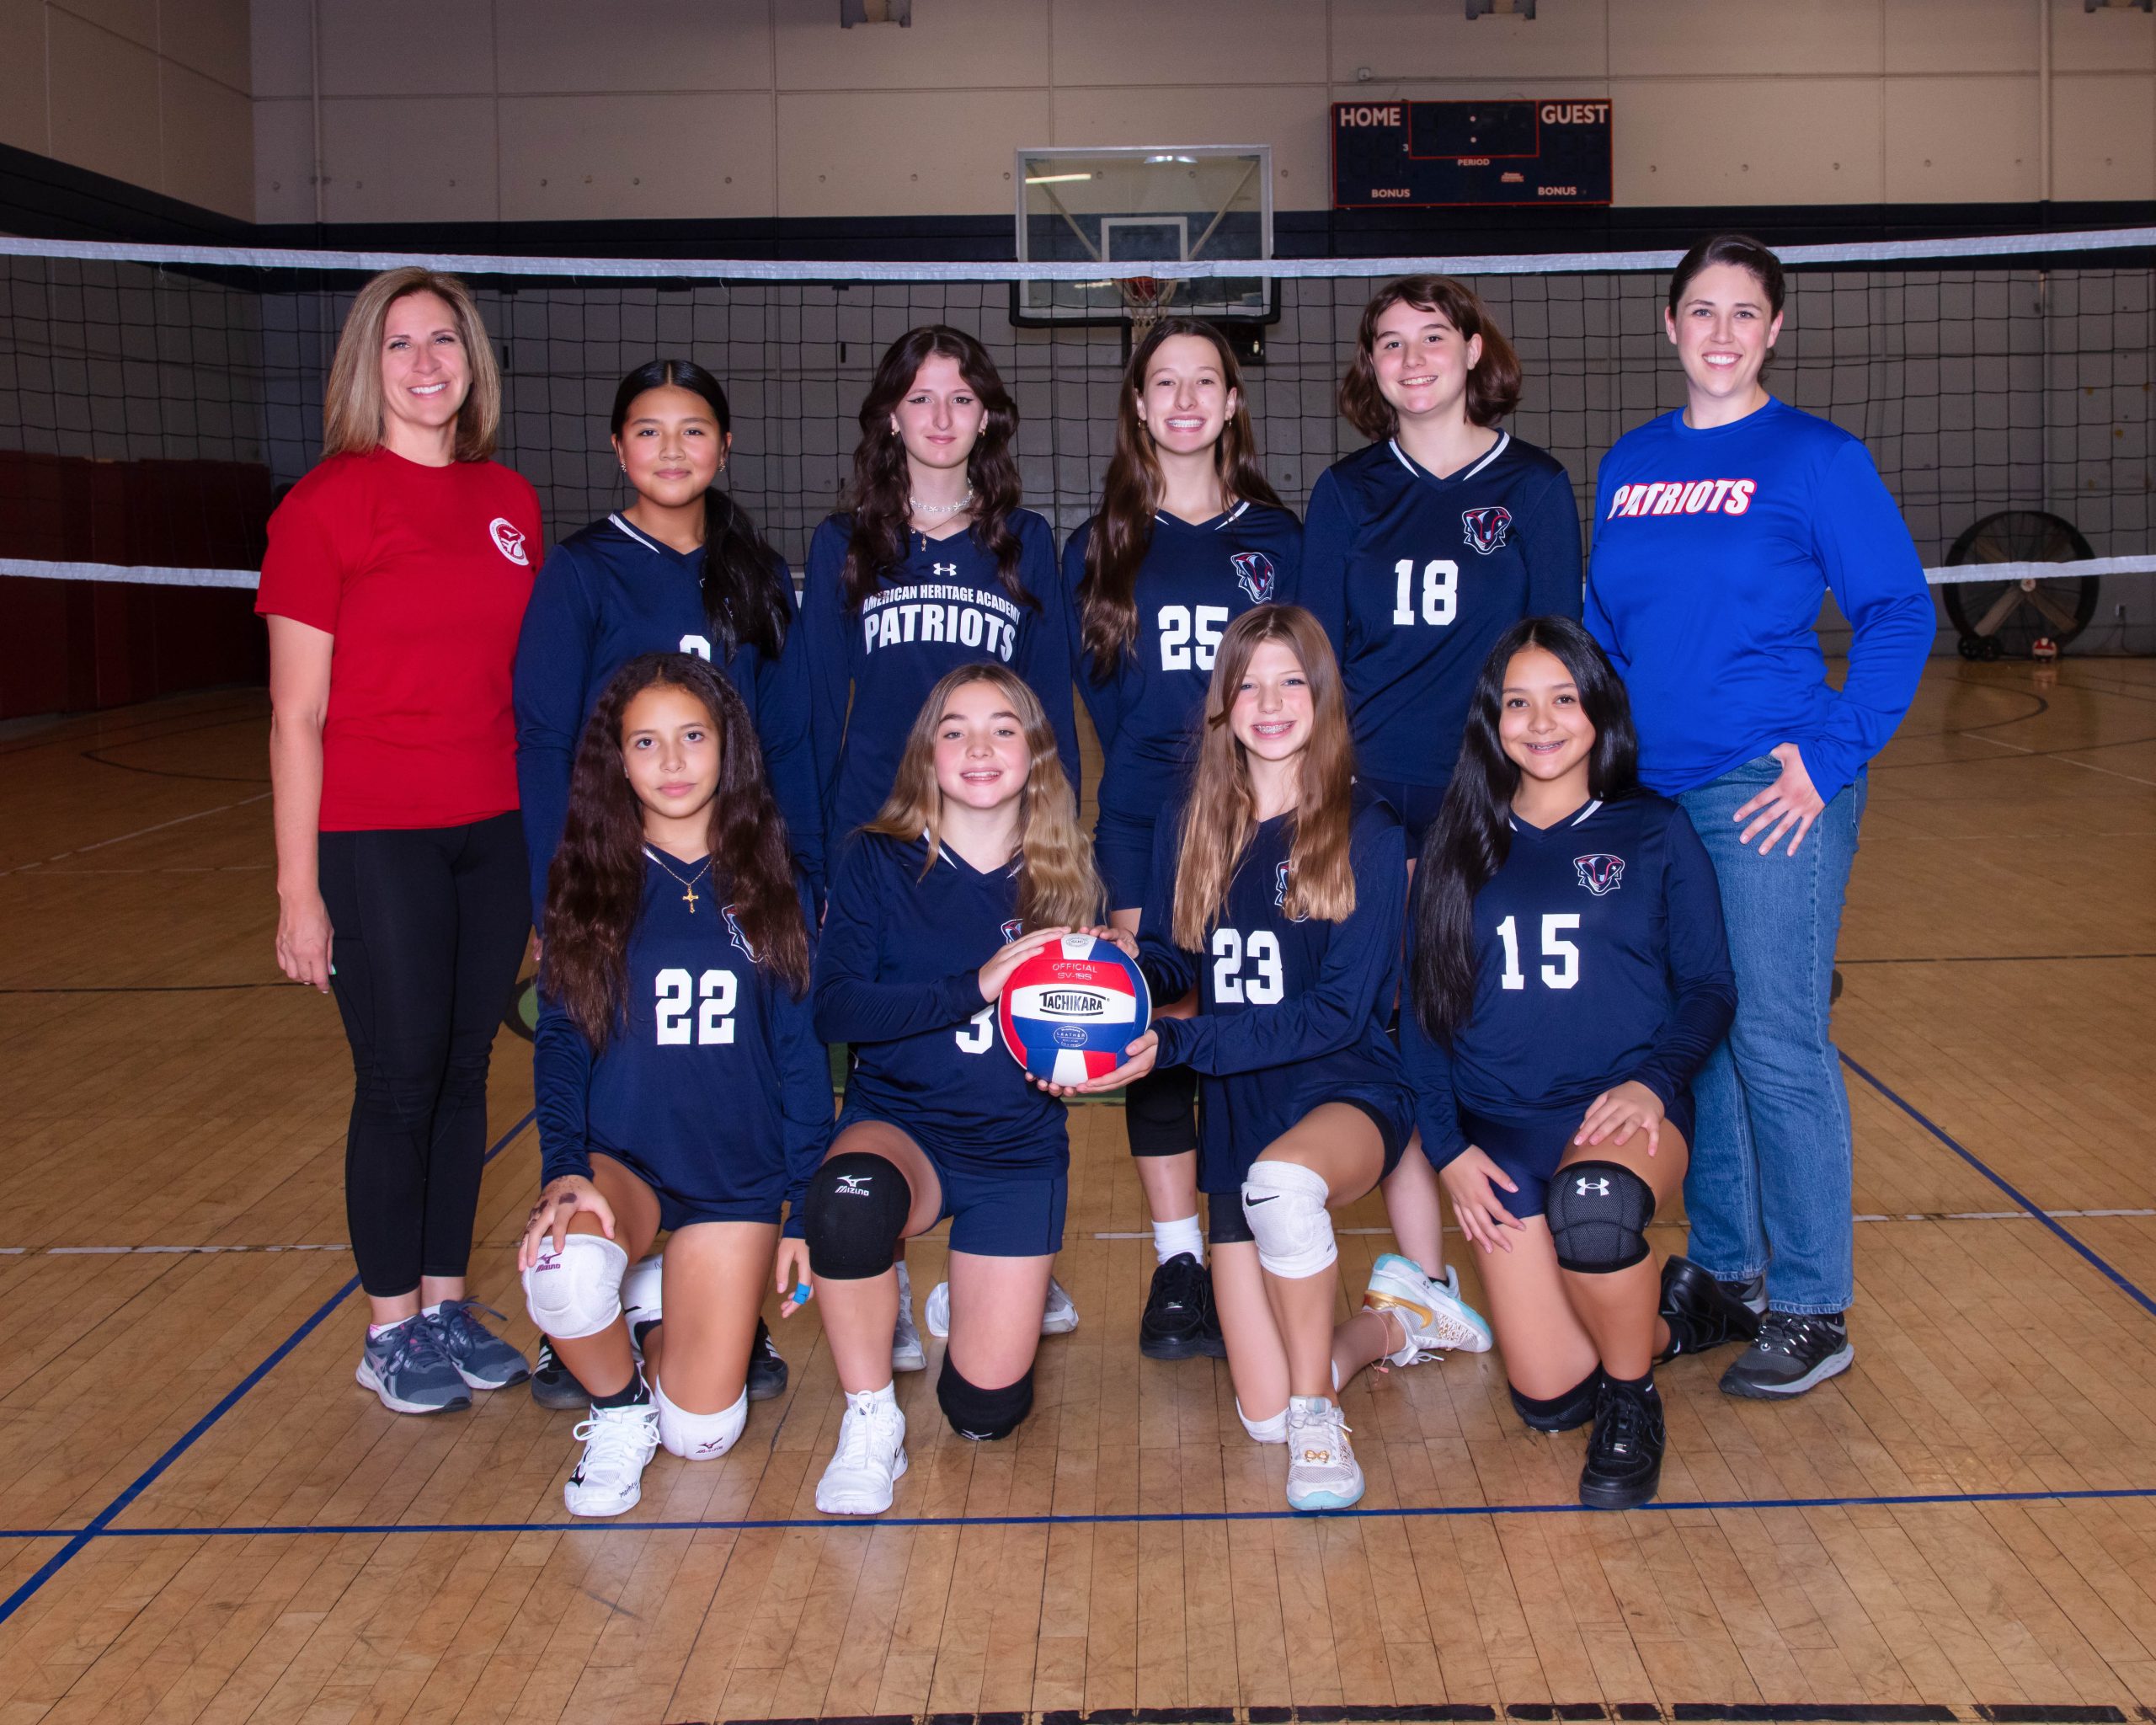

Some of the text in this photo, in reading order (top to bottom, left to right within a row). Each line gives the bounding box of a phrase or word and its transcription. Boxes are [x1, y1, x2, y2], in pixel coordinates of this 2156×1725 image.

[1340, 107, 1401, 127] HOME
[1541, 104, 1609, 125] GUEST
[1457, 158, 1490, 167] PERIOD
[1371, 189, 1411, 199] BONUS
[1538, 186, 1577, 195] BONUS
[1606, 478, 1758, 520] PATRIOTS
[862, 585, 1021, 626] AMERICAN HERITAGE ACADEMY
[1394, 559, 1459, 626] 18
[864, 604, 1016, 662] PATRIOTS
[1158, 605, 1229, 671] 25
[1053, 964, 1098, 973] OFFICIAL
[1212, 928, 1284, 1005] 23
[1497, 914, 1580, 990] 15
[655, 969, 738, 1045] 22
[1040, 991, 1104, 1012] TACHIKARA
